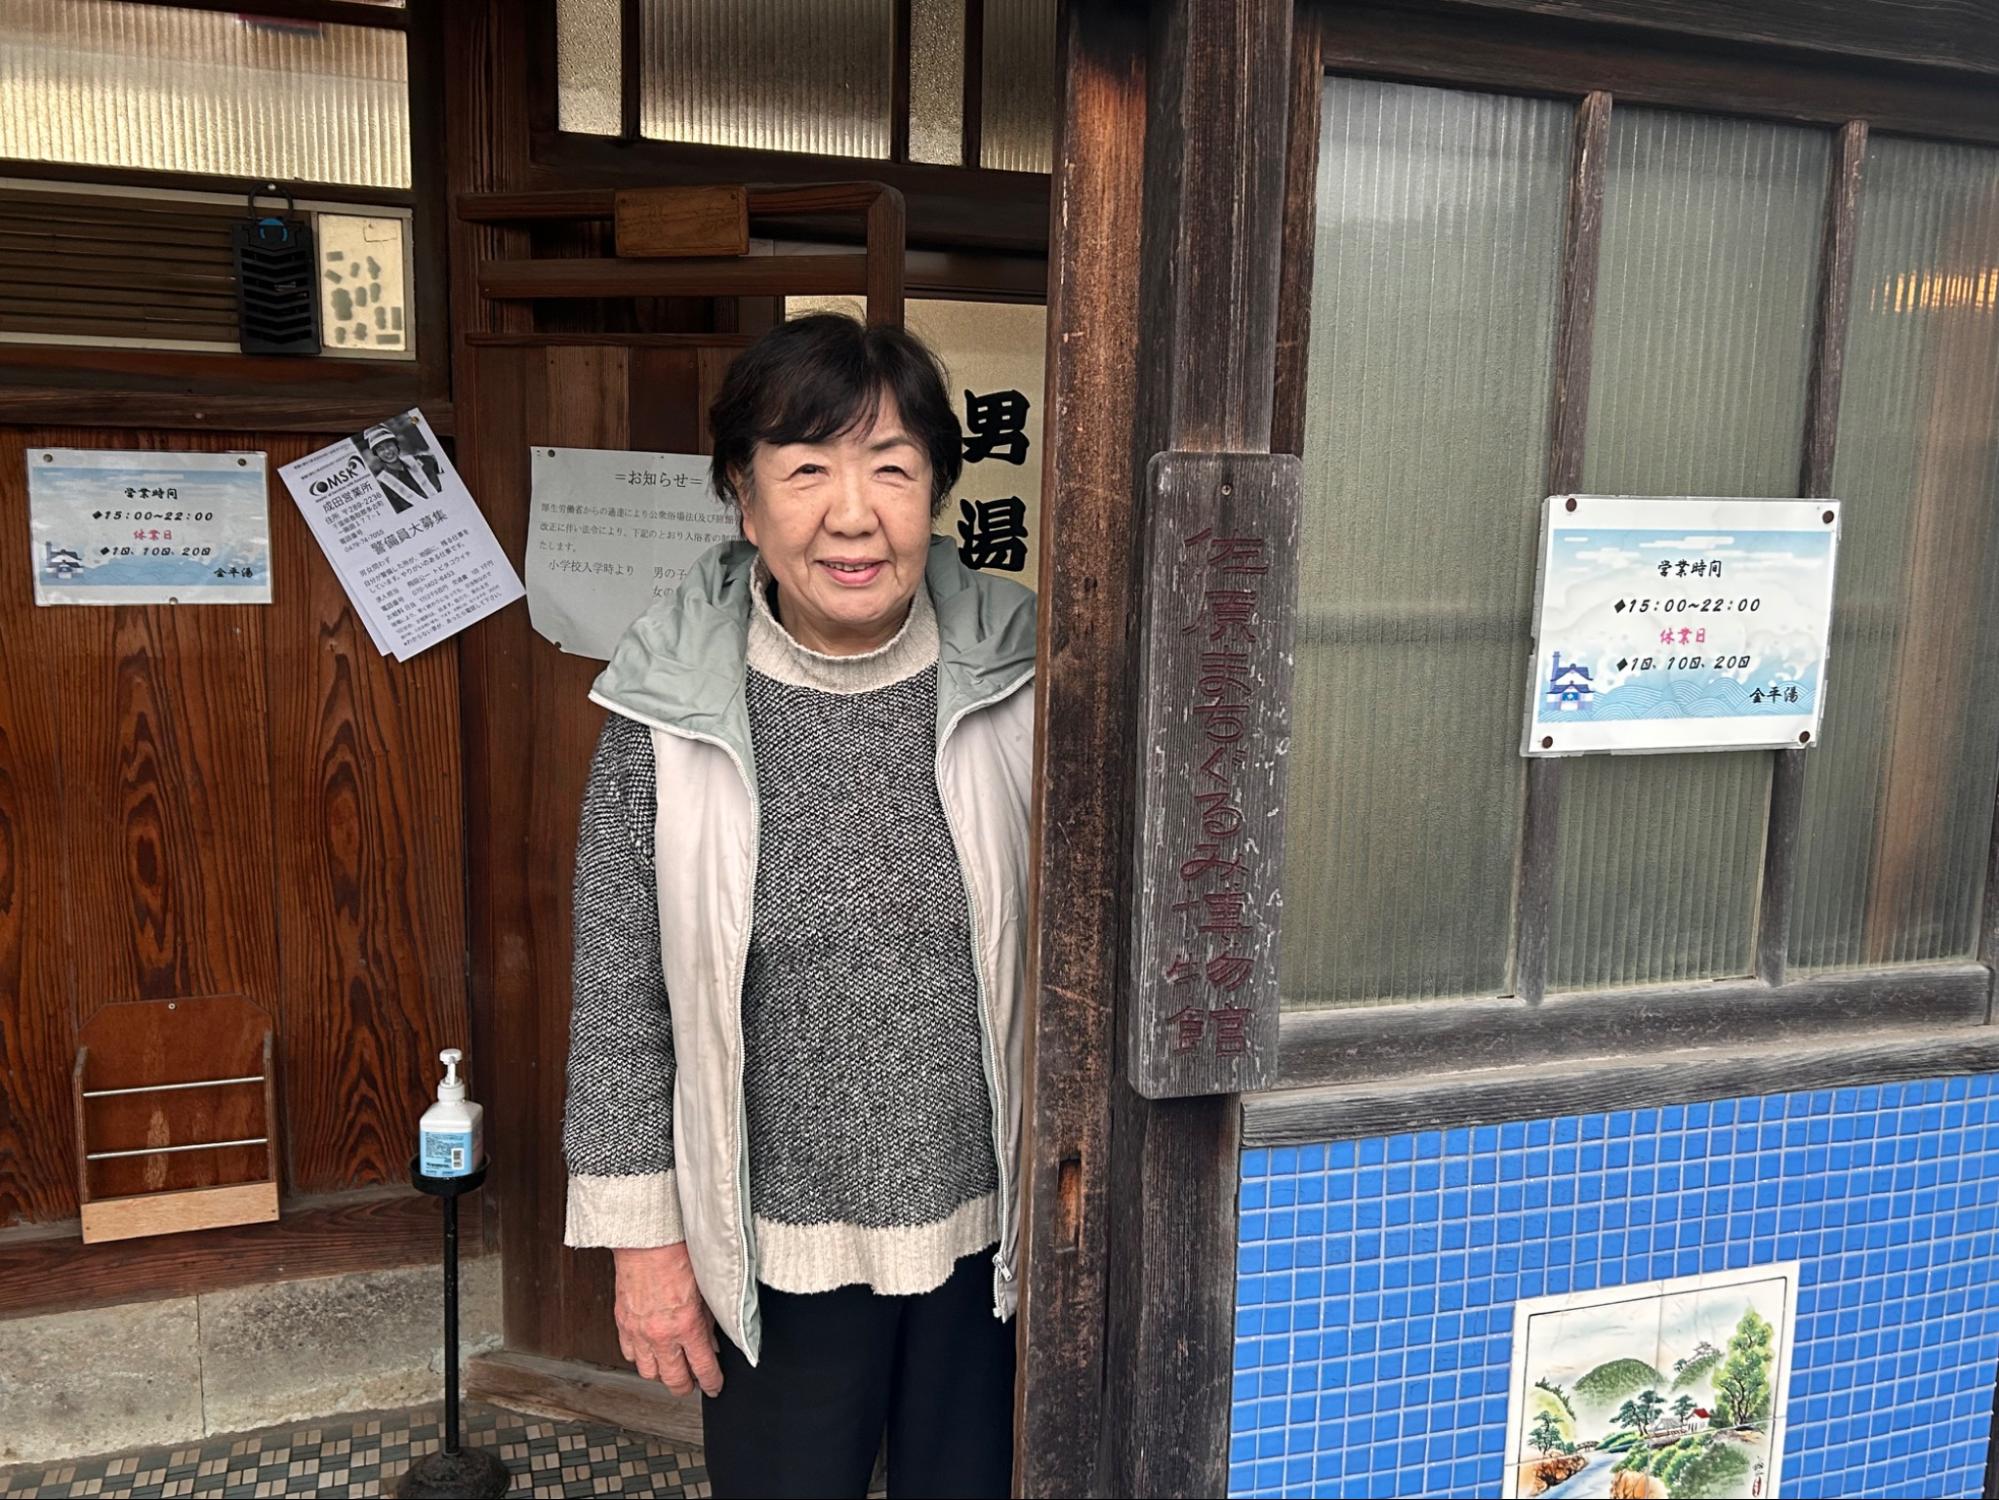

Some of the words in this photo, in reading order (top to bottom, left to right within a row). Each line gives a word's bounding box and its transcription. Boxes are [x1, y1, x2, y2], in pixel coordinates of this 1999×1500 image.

[957, 389, 1031, 572] 男湯
[124, 487, 178, 500] 営業時間
[320, 481, 373, 512] 成田営業所
[133, 529, 173, 541] 休業日
[370, 507, 448, 555] 警備員大募集
[214, 567, 253, 578] 金平湯
[548, 560, 634, 576] 小学校入学時より
[653, 566, 687, 581] 男の子
[1658, 559, 1722, 578] 営業時間
[1660, 628, 1706, 645] 休業日
[1750, 687, 1799, 703] 金平湯
[1166, 527, 1269, 1057] 佐原まちぐるみ博物館
